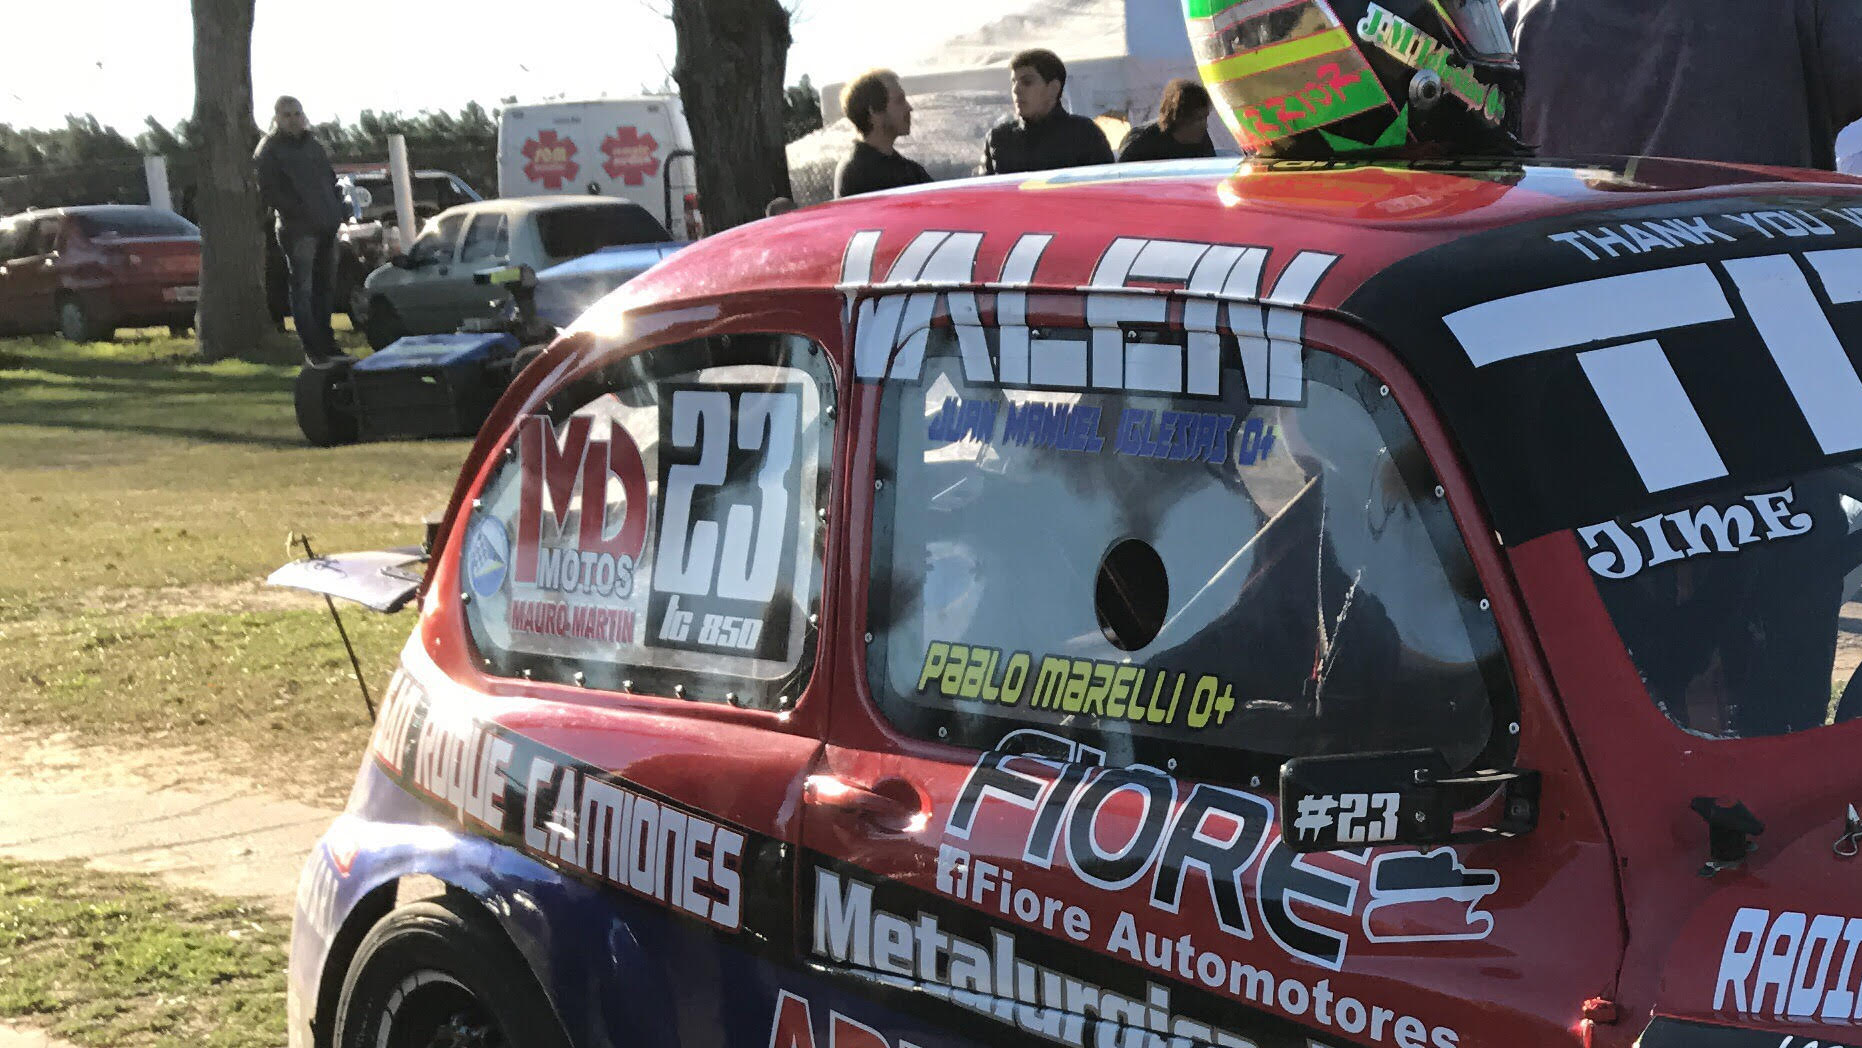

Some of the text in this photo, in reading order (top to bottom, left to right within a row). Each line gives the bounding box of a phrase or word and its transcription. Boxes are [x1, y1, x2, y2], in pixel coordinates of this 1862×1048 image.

[1548, 216, 1738, 261] THANK
[1722, 210, 1836, 239] YOU
[836, 228, 1343, 408] VALEN
[928, 395, 1000, 444] JUAN
[1003, 401, 1104, 453] MANUEL
[1113, 408, 1235, 464] IGLESIAS
[513, 413, 650, 588] MD
[652, 390, 803, 600] 23
[1576, 485, 1815, 581] JIME
[537, 547, 635, 599] MOTOS
[697, 609, 764, 651] 850
[523, 756, 748, 933] CAMIONES
[945, 728, 1374, 972] FIORE
[1294, 790, 1401, 843] #23
[972, 858, 1092, 940] Fiore
